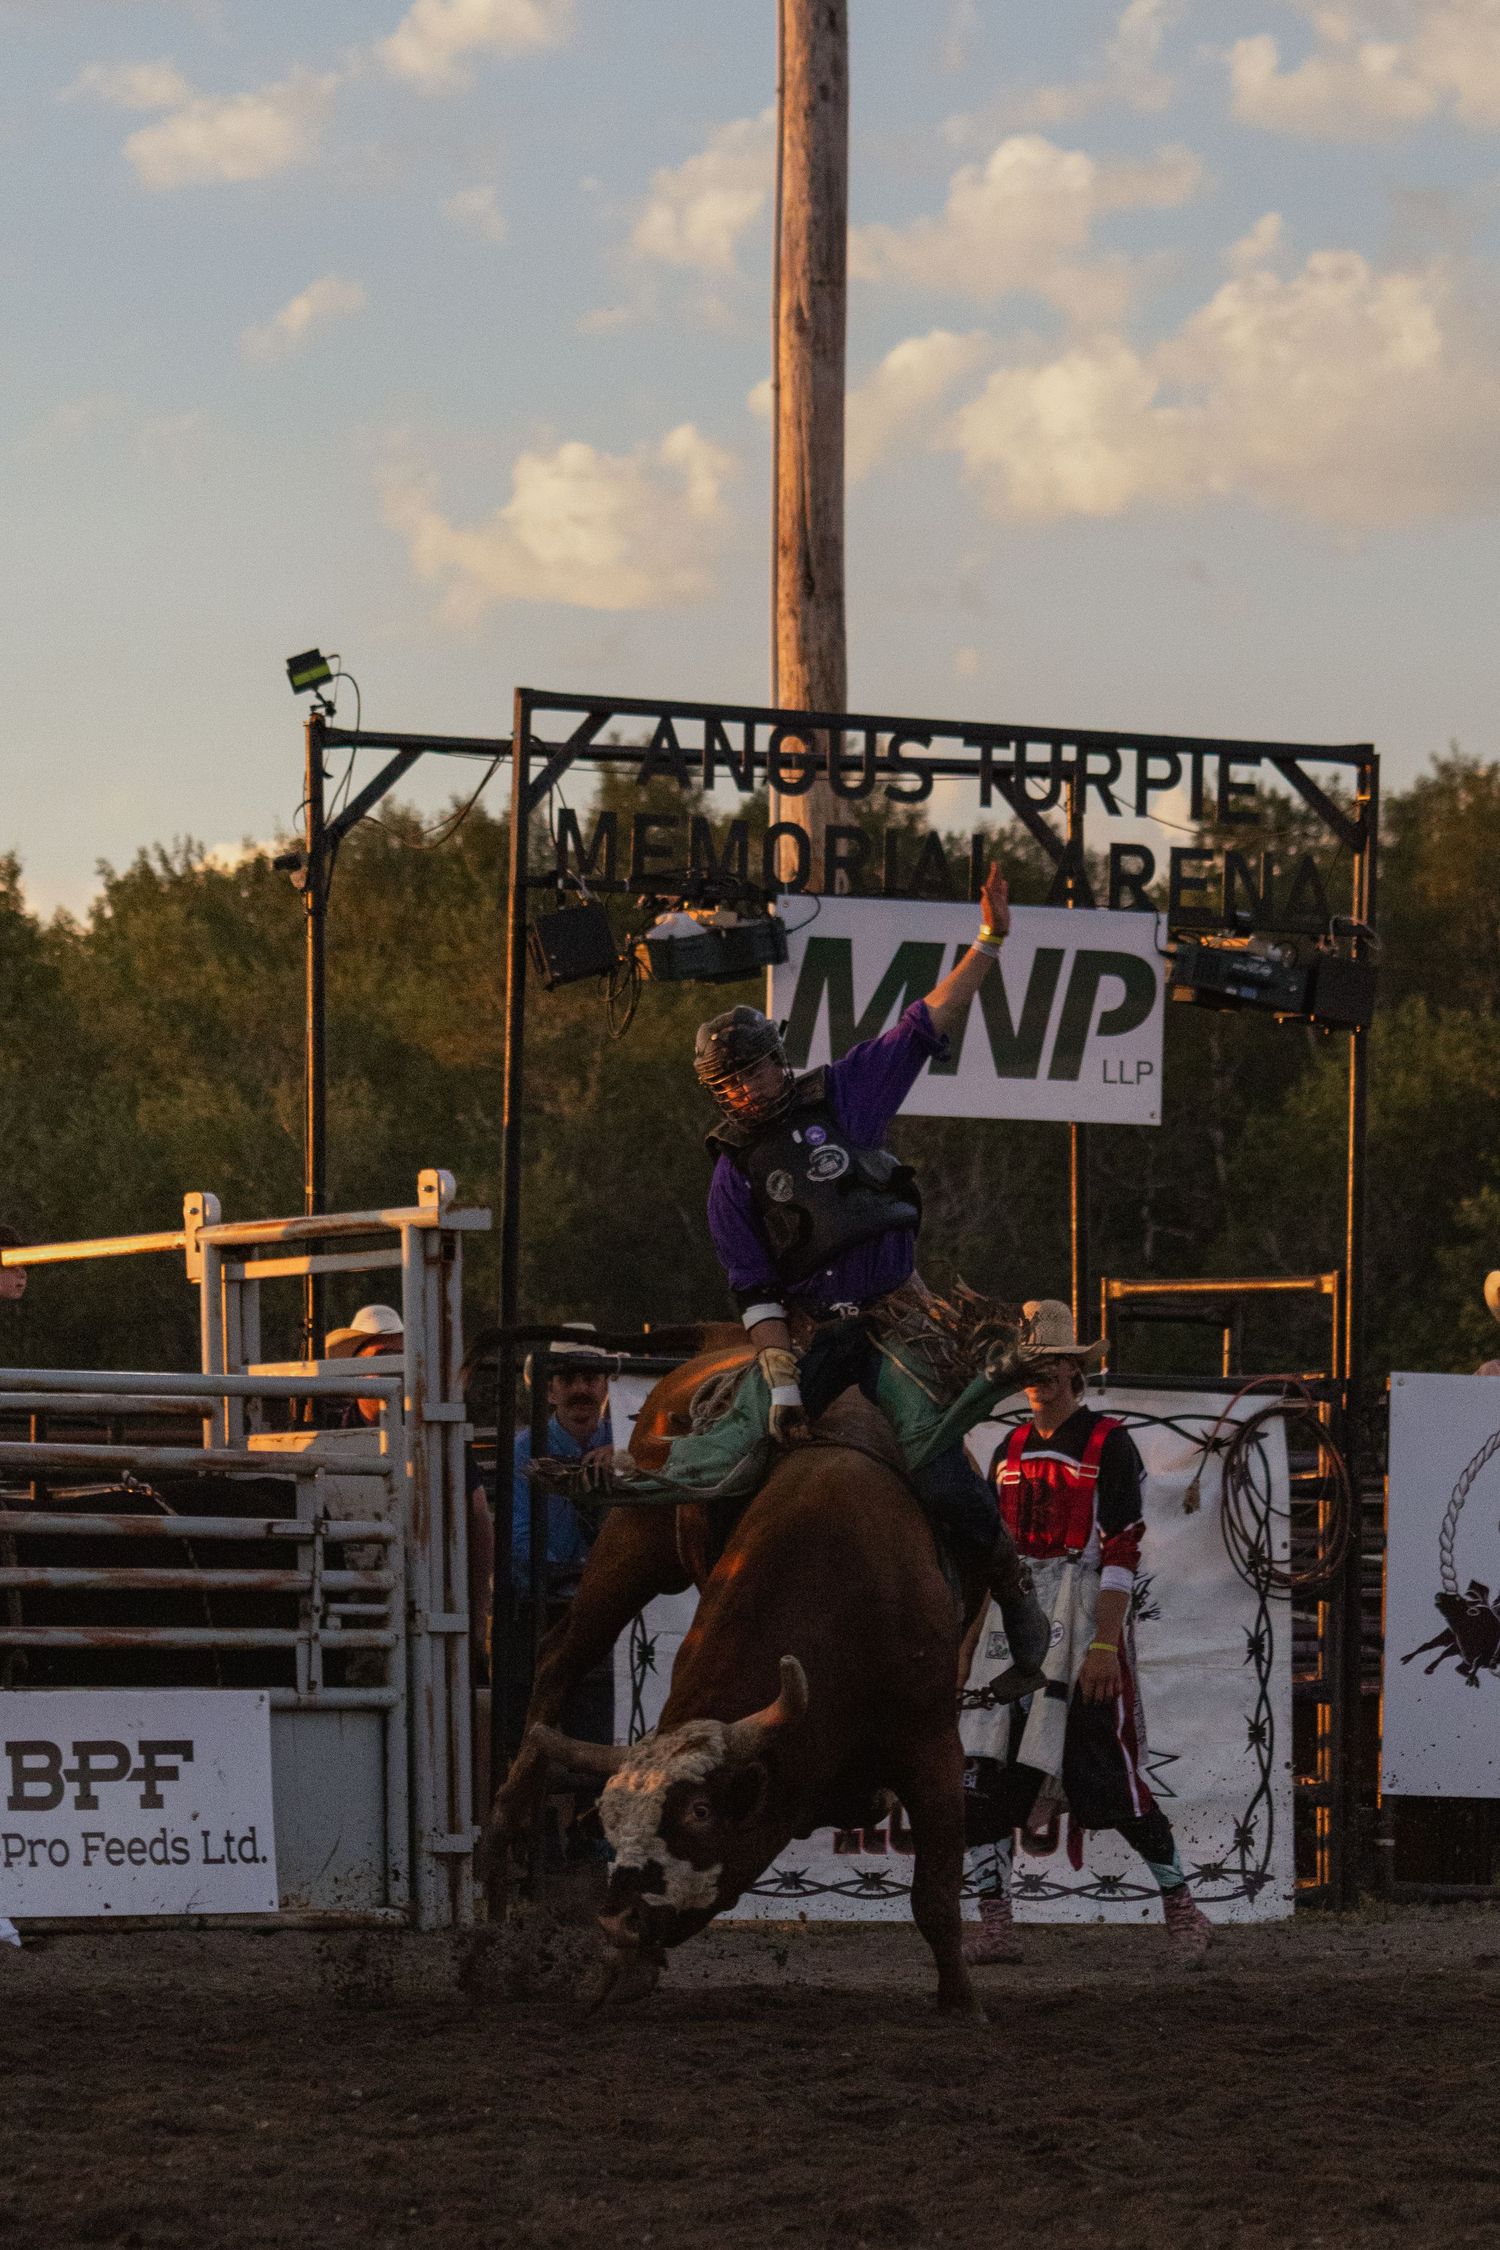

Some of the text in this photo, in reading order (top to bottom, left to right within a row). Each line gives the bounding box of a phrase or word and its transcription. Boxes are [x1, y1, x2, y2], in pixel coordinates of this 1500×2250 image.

[637, 714, 1262, 824] ANGUS TURPIE
[1049, 840, 1330, 931] ARENA
[782, 936, 1157, 1081] MNP
[1103, 1060, 1153, 1084] LLP
[5, 1740, 194, 1811] BPF
[2, 1826, 267, 1868] Pro Feeds Ltd.
